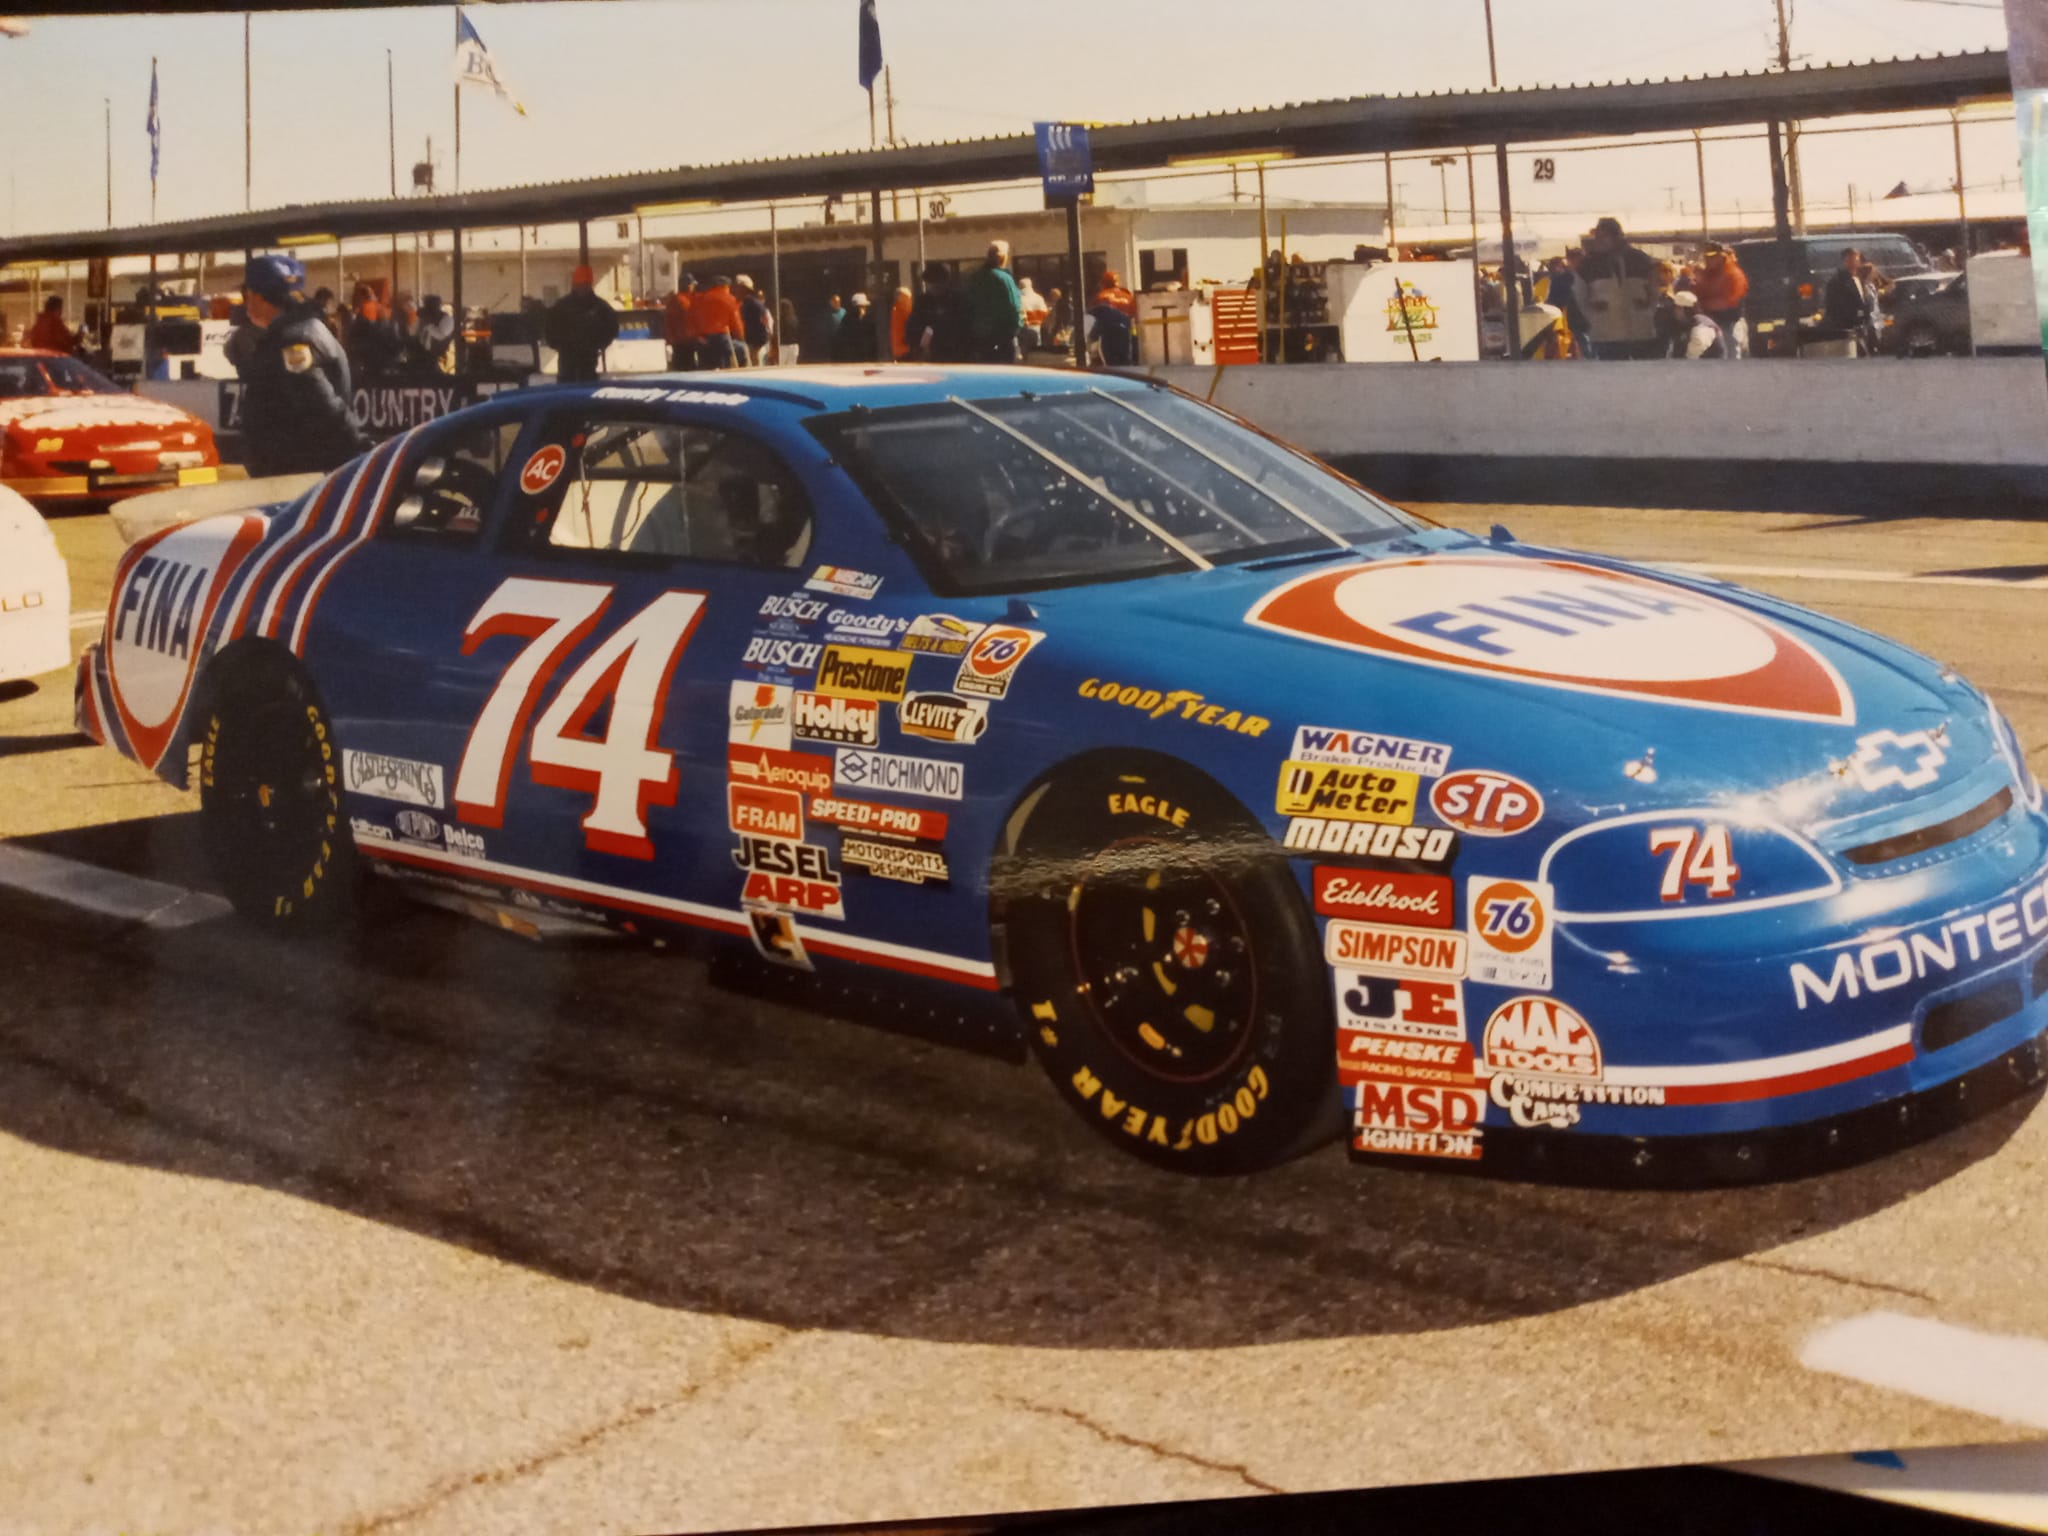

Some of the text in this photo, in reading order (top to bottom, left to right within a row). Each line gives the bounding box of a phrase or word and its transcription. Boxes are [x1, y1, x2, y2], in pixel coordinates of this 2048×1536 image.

[1534, 158, 1554, 181] 29
[929, 201, 945, 220] 30
[350, 386, 454, 427] OUNTRY
[526, 458, 559, 481] AC
[115, 555, 208, 661] FINA
[759, 595, 829, 619] BUSCH
[826, 608, 909, 636] Goody's
[1389, 584, 1704, 656] FINA
[742, 637, 822, 668] BUSCH
[977, 638, 1023, 662] 76
[820, 651, 904, 693] Prestone
[452, 576, 709, 861] 74
[795, 694, 876, 743] Holley
[1078, 678, 1271, 737] GOODYEAR
[1301, 751, 1350, 764] Brake
[1302, 729, 1444, 764] WAGNER
[752, 752, 830, 791] Aeroquip
[870, 756, 959, 795] RICHMOND
[1320, 769, 1397, 793] Auto
[1108, 793, 1191, 828] EAGLE
[1312, 788, 1408, 815] Meter
[1442, 776, 1528, 823] STP
[443, 823, 485, 850] Delco
[736, 805, 796, 833] FRAM
[846, 841, 941, 870] MOTORSPORTS
[1284, 817, 1454, 862] MOROSO
[733, 836, 840, 884] JESEL
[1649, 824, 1740, 901] 74
[744, 872, 840, 910] ARP
[1323, 878, 1440, 915] Edelbrock
[1484, 898, 1534, 938] 76
[1337, 929, 1456, 969] SIMPSON
[1344, 974, 1458, 1027] JE
[1489, 1001, 1594, 1056] MAC
[1349, 1035, 1462, 1065] PENSKE
[1491, 1050, 1595, 1076] TOOLS
[1072, 1064, 1269, 1150] GOODYEAR
[1361, 1083, 1478, 1132] MSD
[1490, 1072, 1666, 1108] COMPETITION
[1510, 1094, 1581, 1128] CAMS
